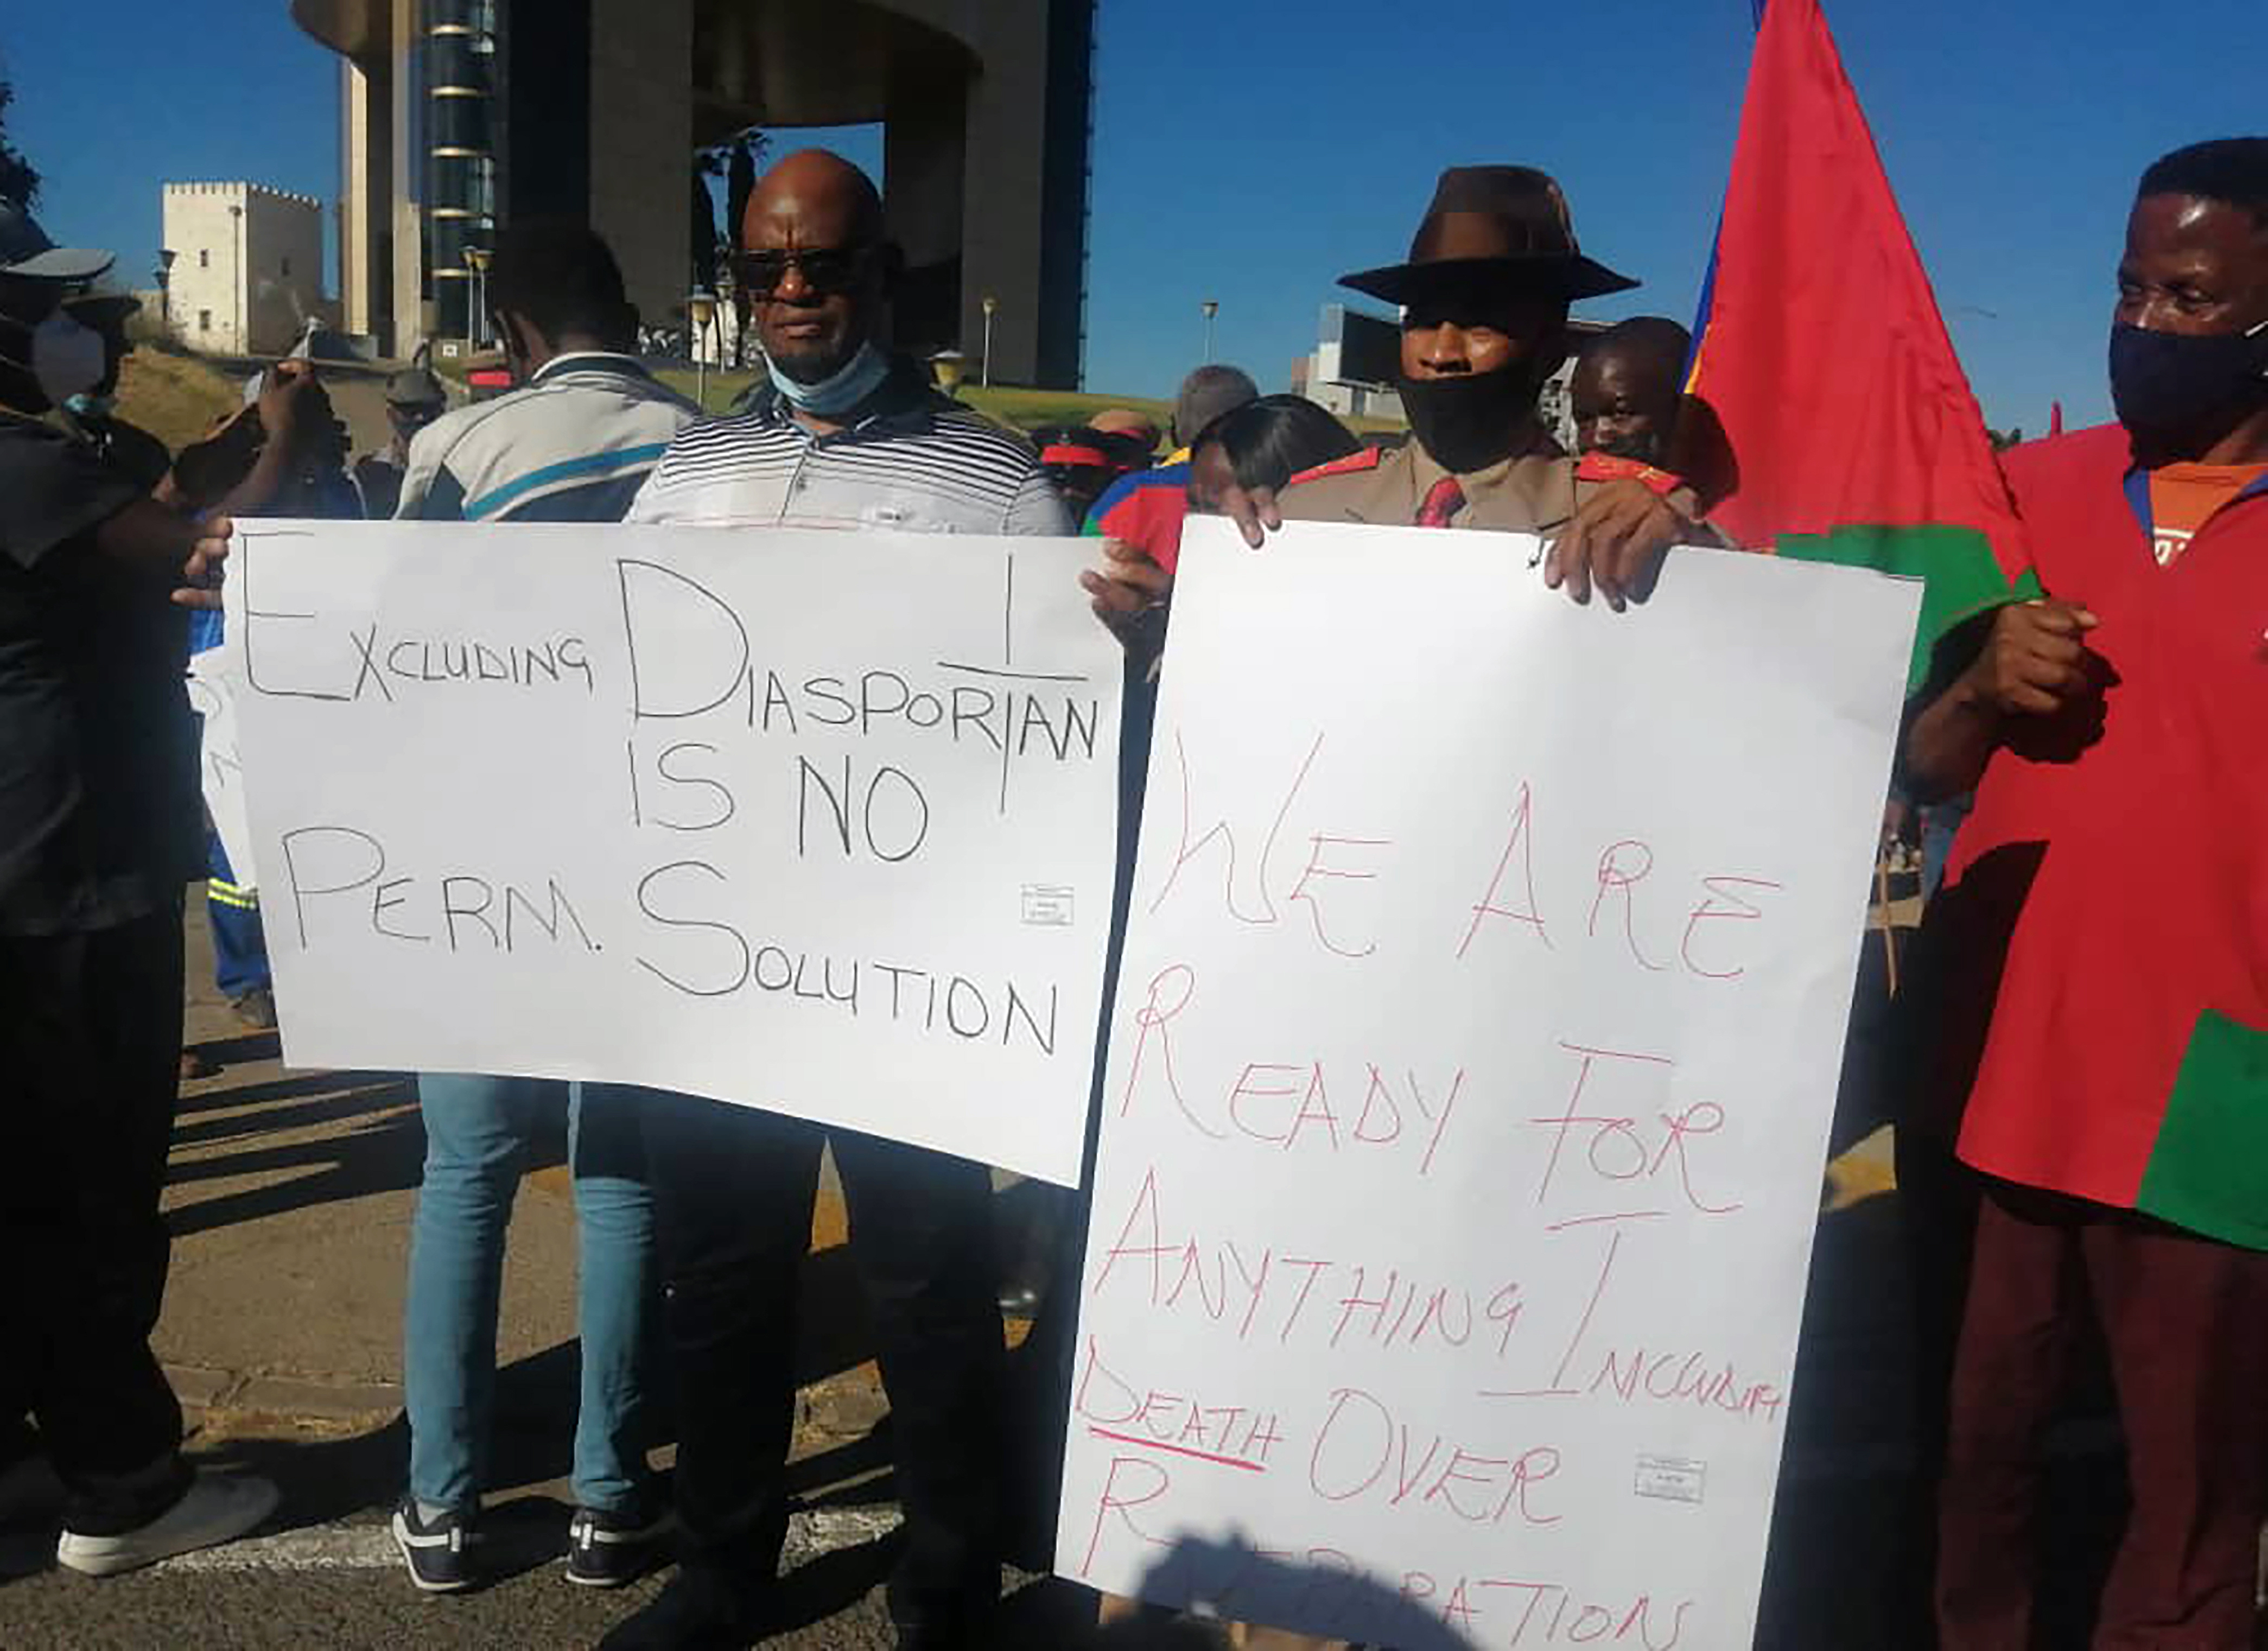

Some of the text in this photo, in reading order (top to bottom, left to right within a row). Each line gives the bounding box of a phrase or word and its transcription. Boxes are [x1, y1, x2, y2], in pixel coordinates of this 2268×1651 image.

[240, 530, 593, 702] EXCLUDING
[628, 740, 927, 862] IS NO
[1149, 729, 1783, 977] WE ARE
[283, 827, 1057, 1056] PERM. SOLUTION
[1120, 964, 1743, 1212] READY FOR
[1094, 1165, 1523, 1355] ANYTHING
[1075, 1334, 1562, 1523] DEATH OVER
